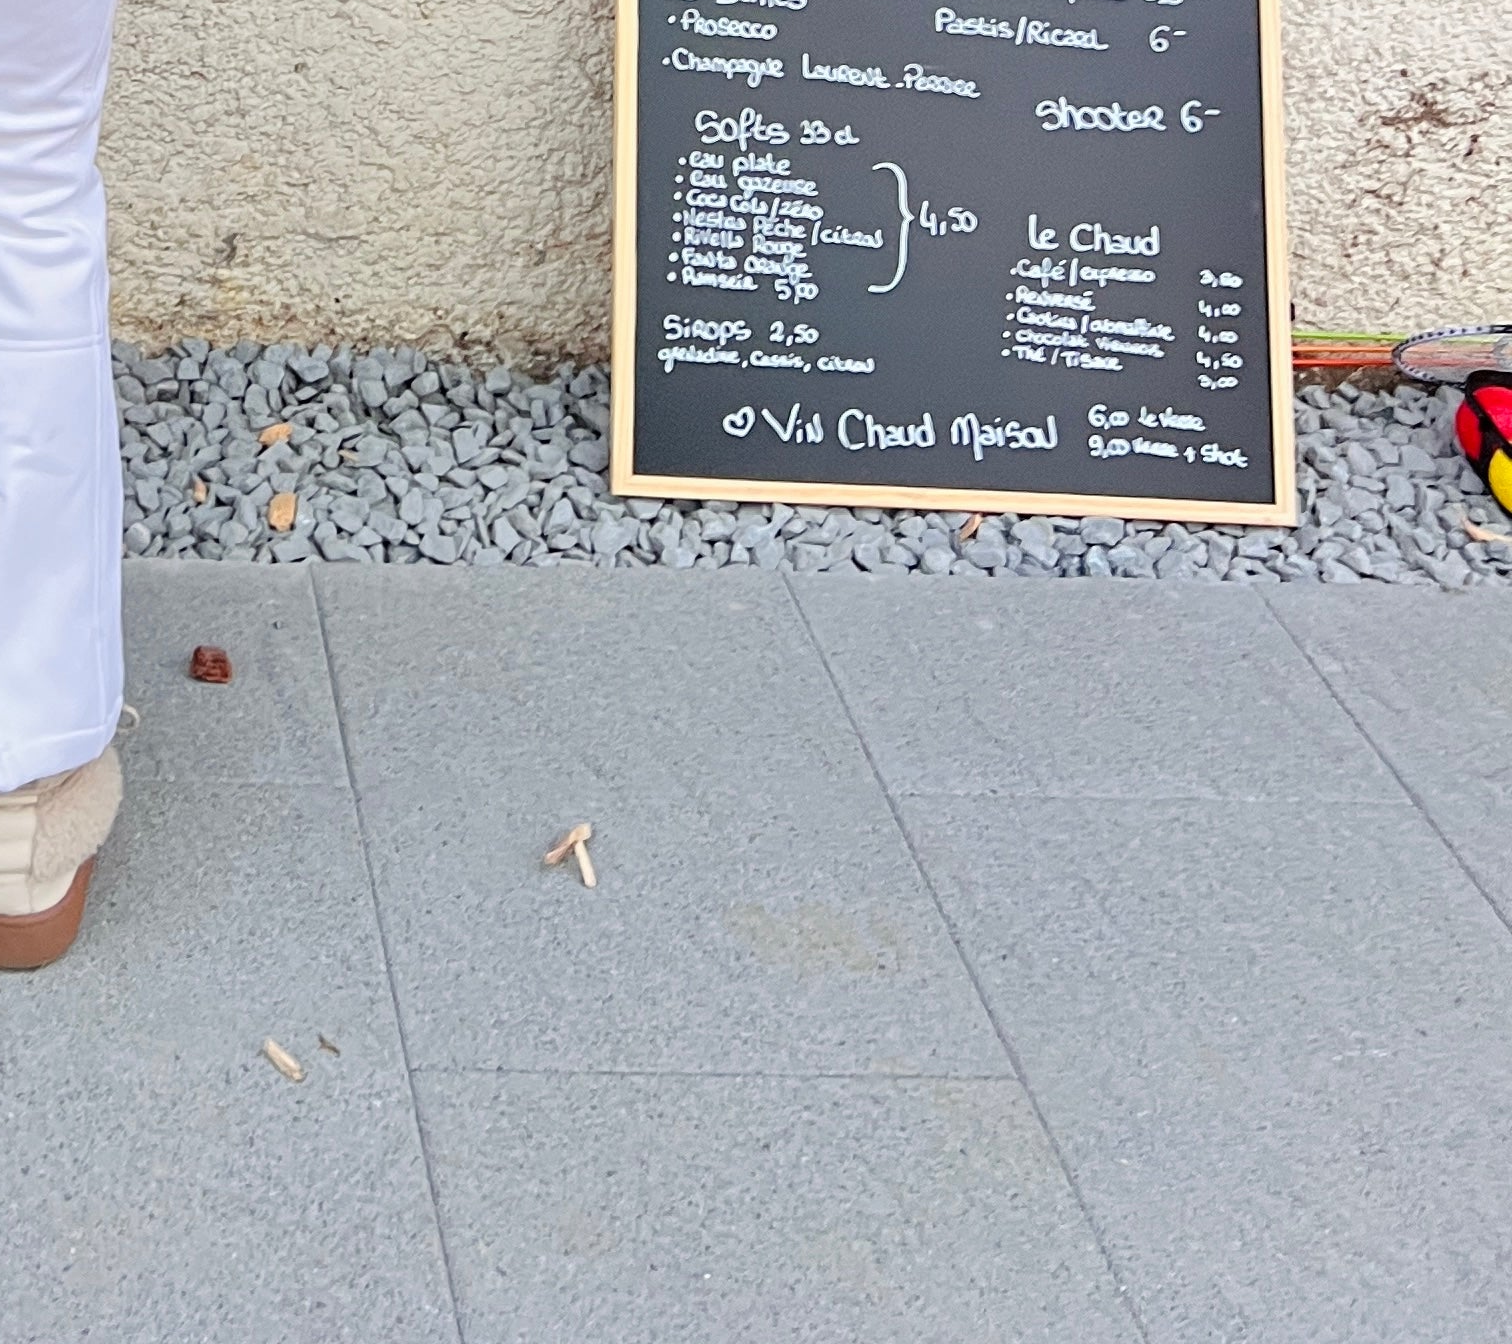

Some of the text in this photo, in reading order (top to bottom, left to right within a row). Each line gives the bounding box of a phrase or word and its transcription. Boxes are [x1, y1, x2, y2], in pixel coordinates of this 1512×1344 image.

[694, 107, 791, 152] Softs
[732, 152, 792, 177] plate
[919, 200, 978, 236] 4,50
[1069, 222, 1160, 256] Chaud
[769, 320, 820, 347] 2,50
[837, 408, 936, 450] Chaud
[1087, 403, 1130, 430] 6,00
[1088, 434, 1131, 459] 9,00
[1200, 443, 1248, 468] Shot
